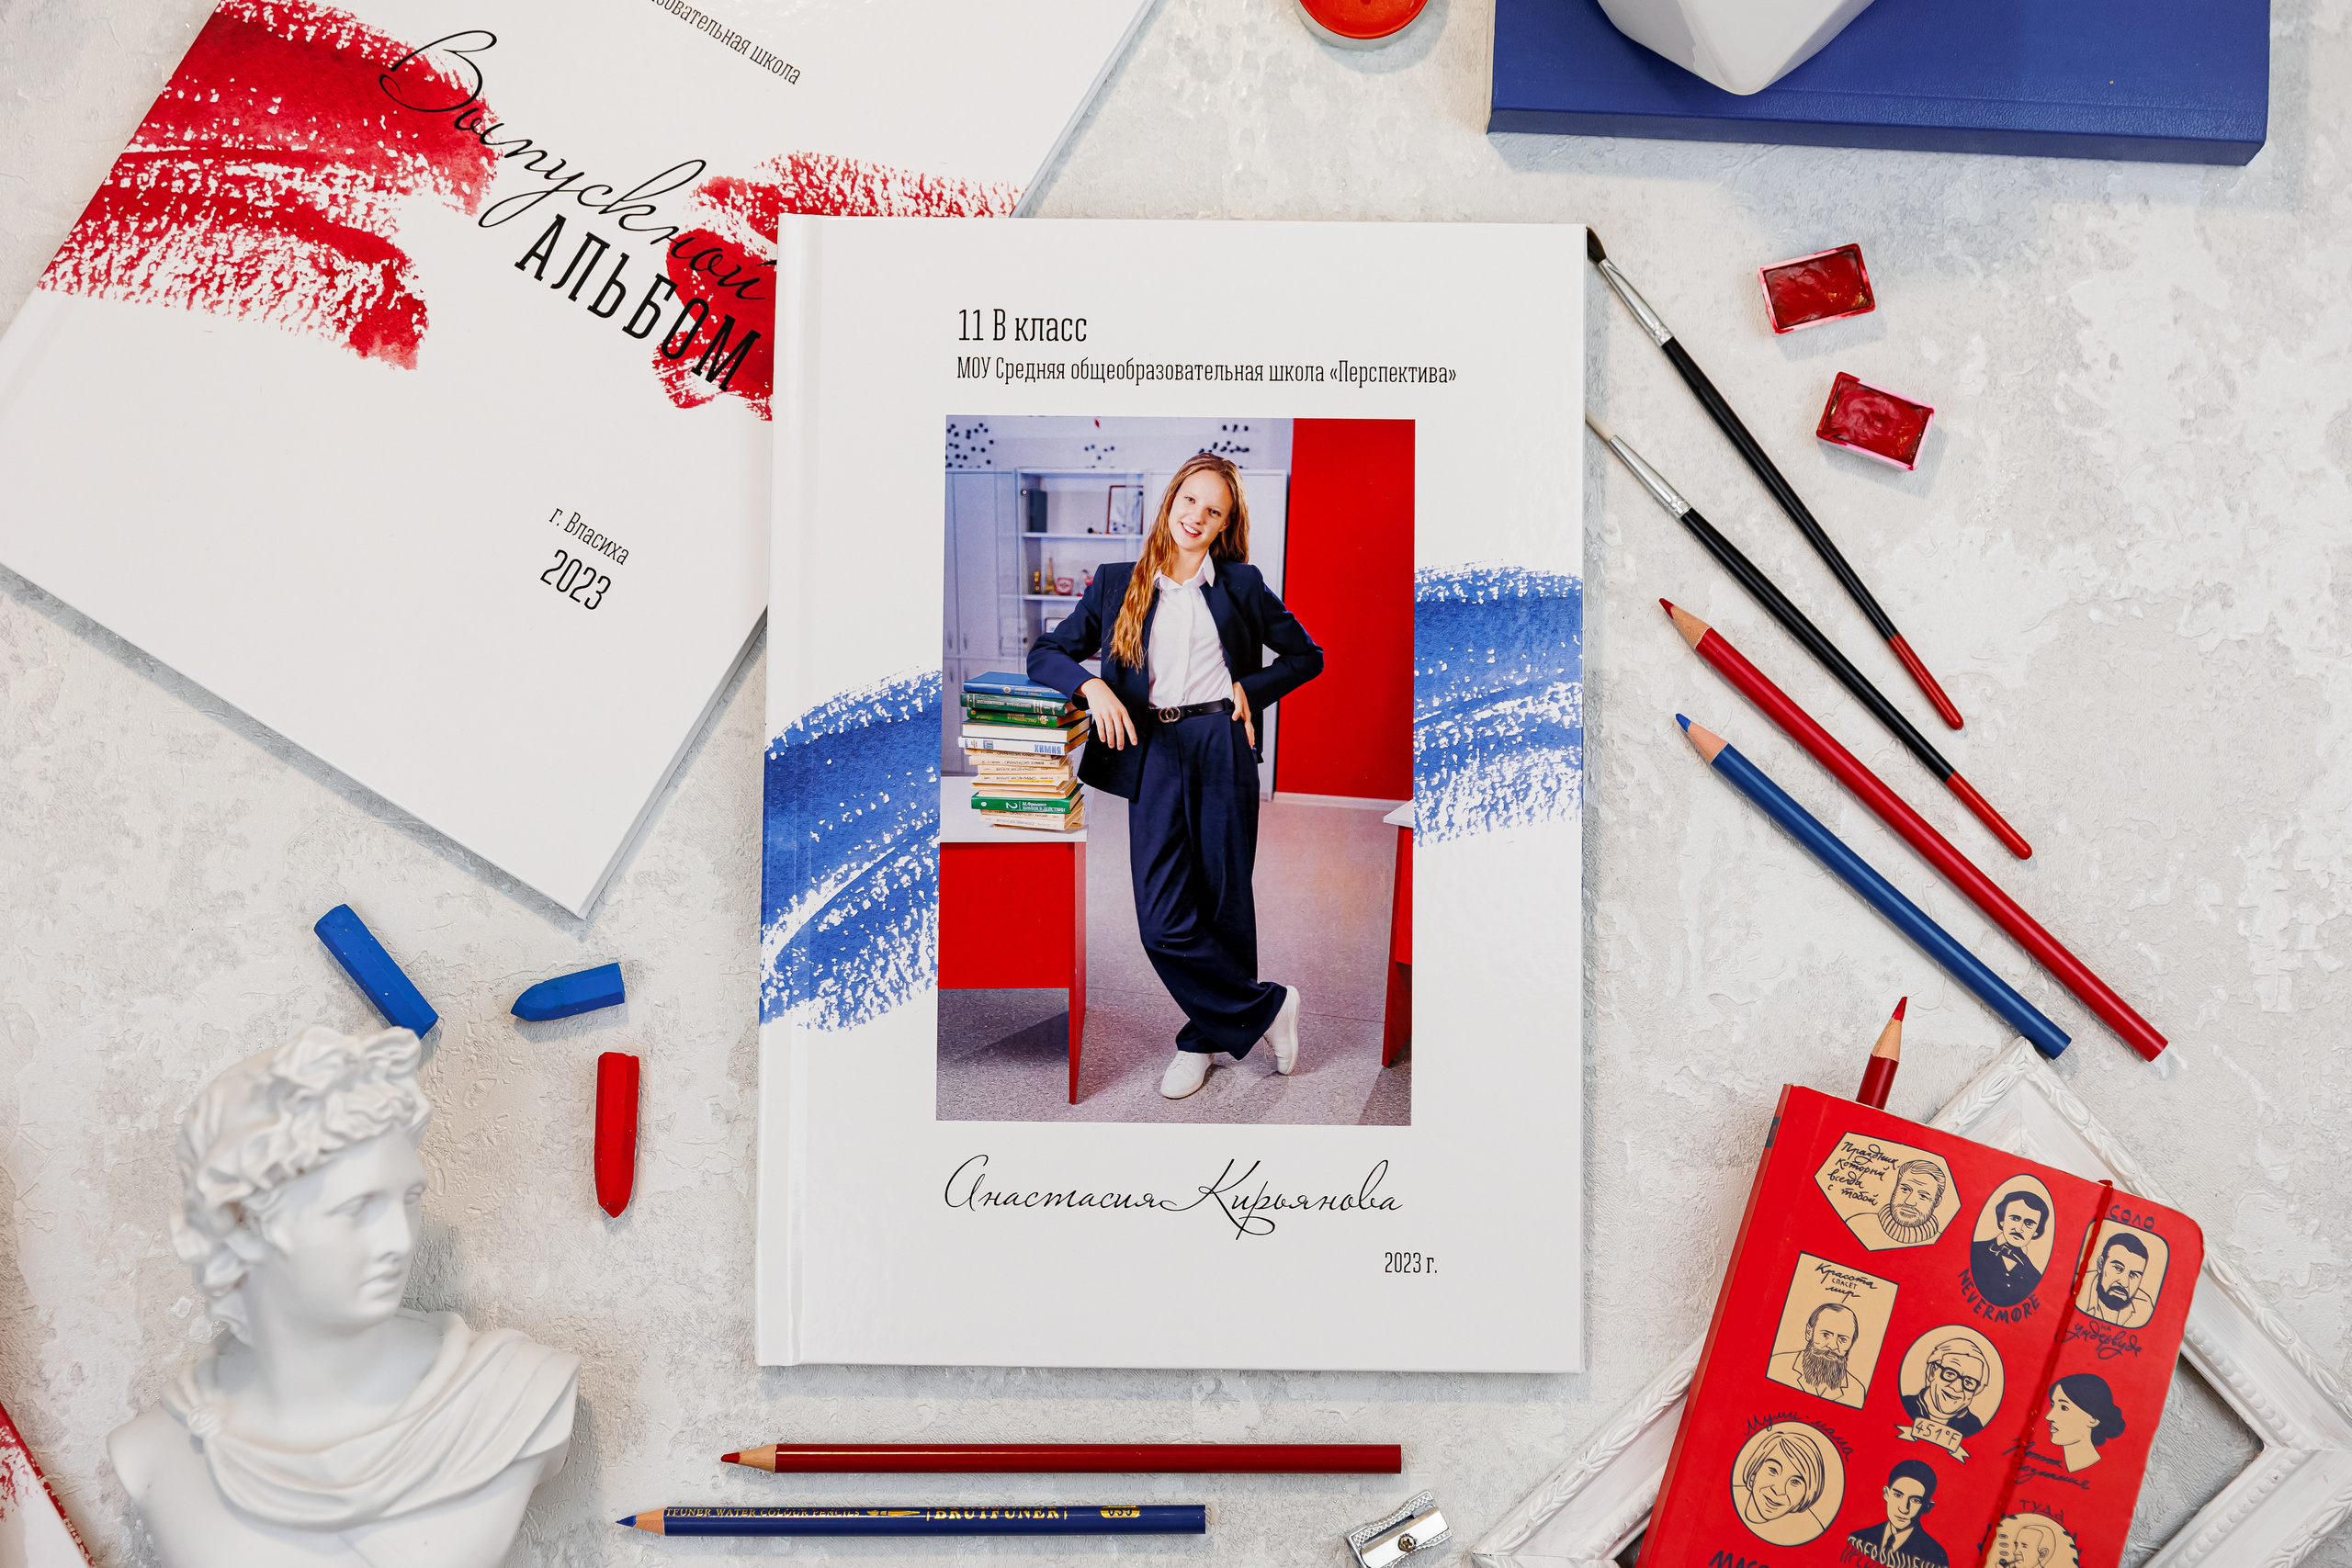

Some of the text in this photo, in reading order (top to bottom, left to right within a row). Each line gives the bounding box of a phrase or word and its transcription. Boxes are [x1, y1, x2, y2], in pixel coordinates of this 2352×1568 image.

[650, 0, 801, 85] овательная школа
[379, 30, 776, 300] Выпускной
[514, 214, 761, 392] АЛЬБОМ
[959, 309, 1086, 342] 11 В класс
[957, 356, 1456, 388] МОУ Средняя общеобразовательная школа «Перспектива»
[548, 508, 629, 565] г. Власиха
[539, 549, 611, 610] 2023
[944, 1154, 1404, 1241] Анастасия Кирьянова
[2109, 1204, 2155, 1230] СОЛО
[1385, 1252, 1437, 1273] 2023 г.
[1815, 1262, 1878, 1290] Красота
[1958, 1268, 2041, 1325] NEVERMORE
